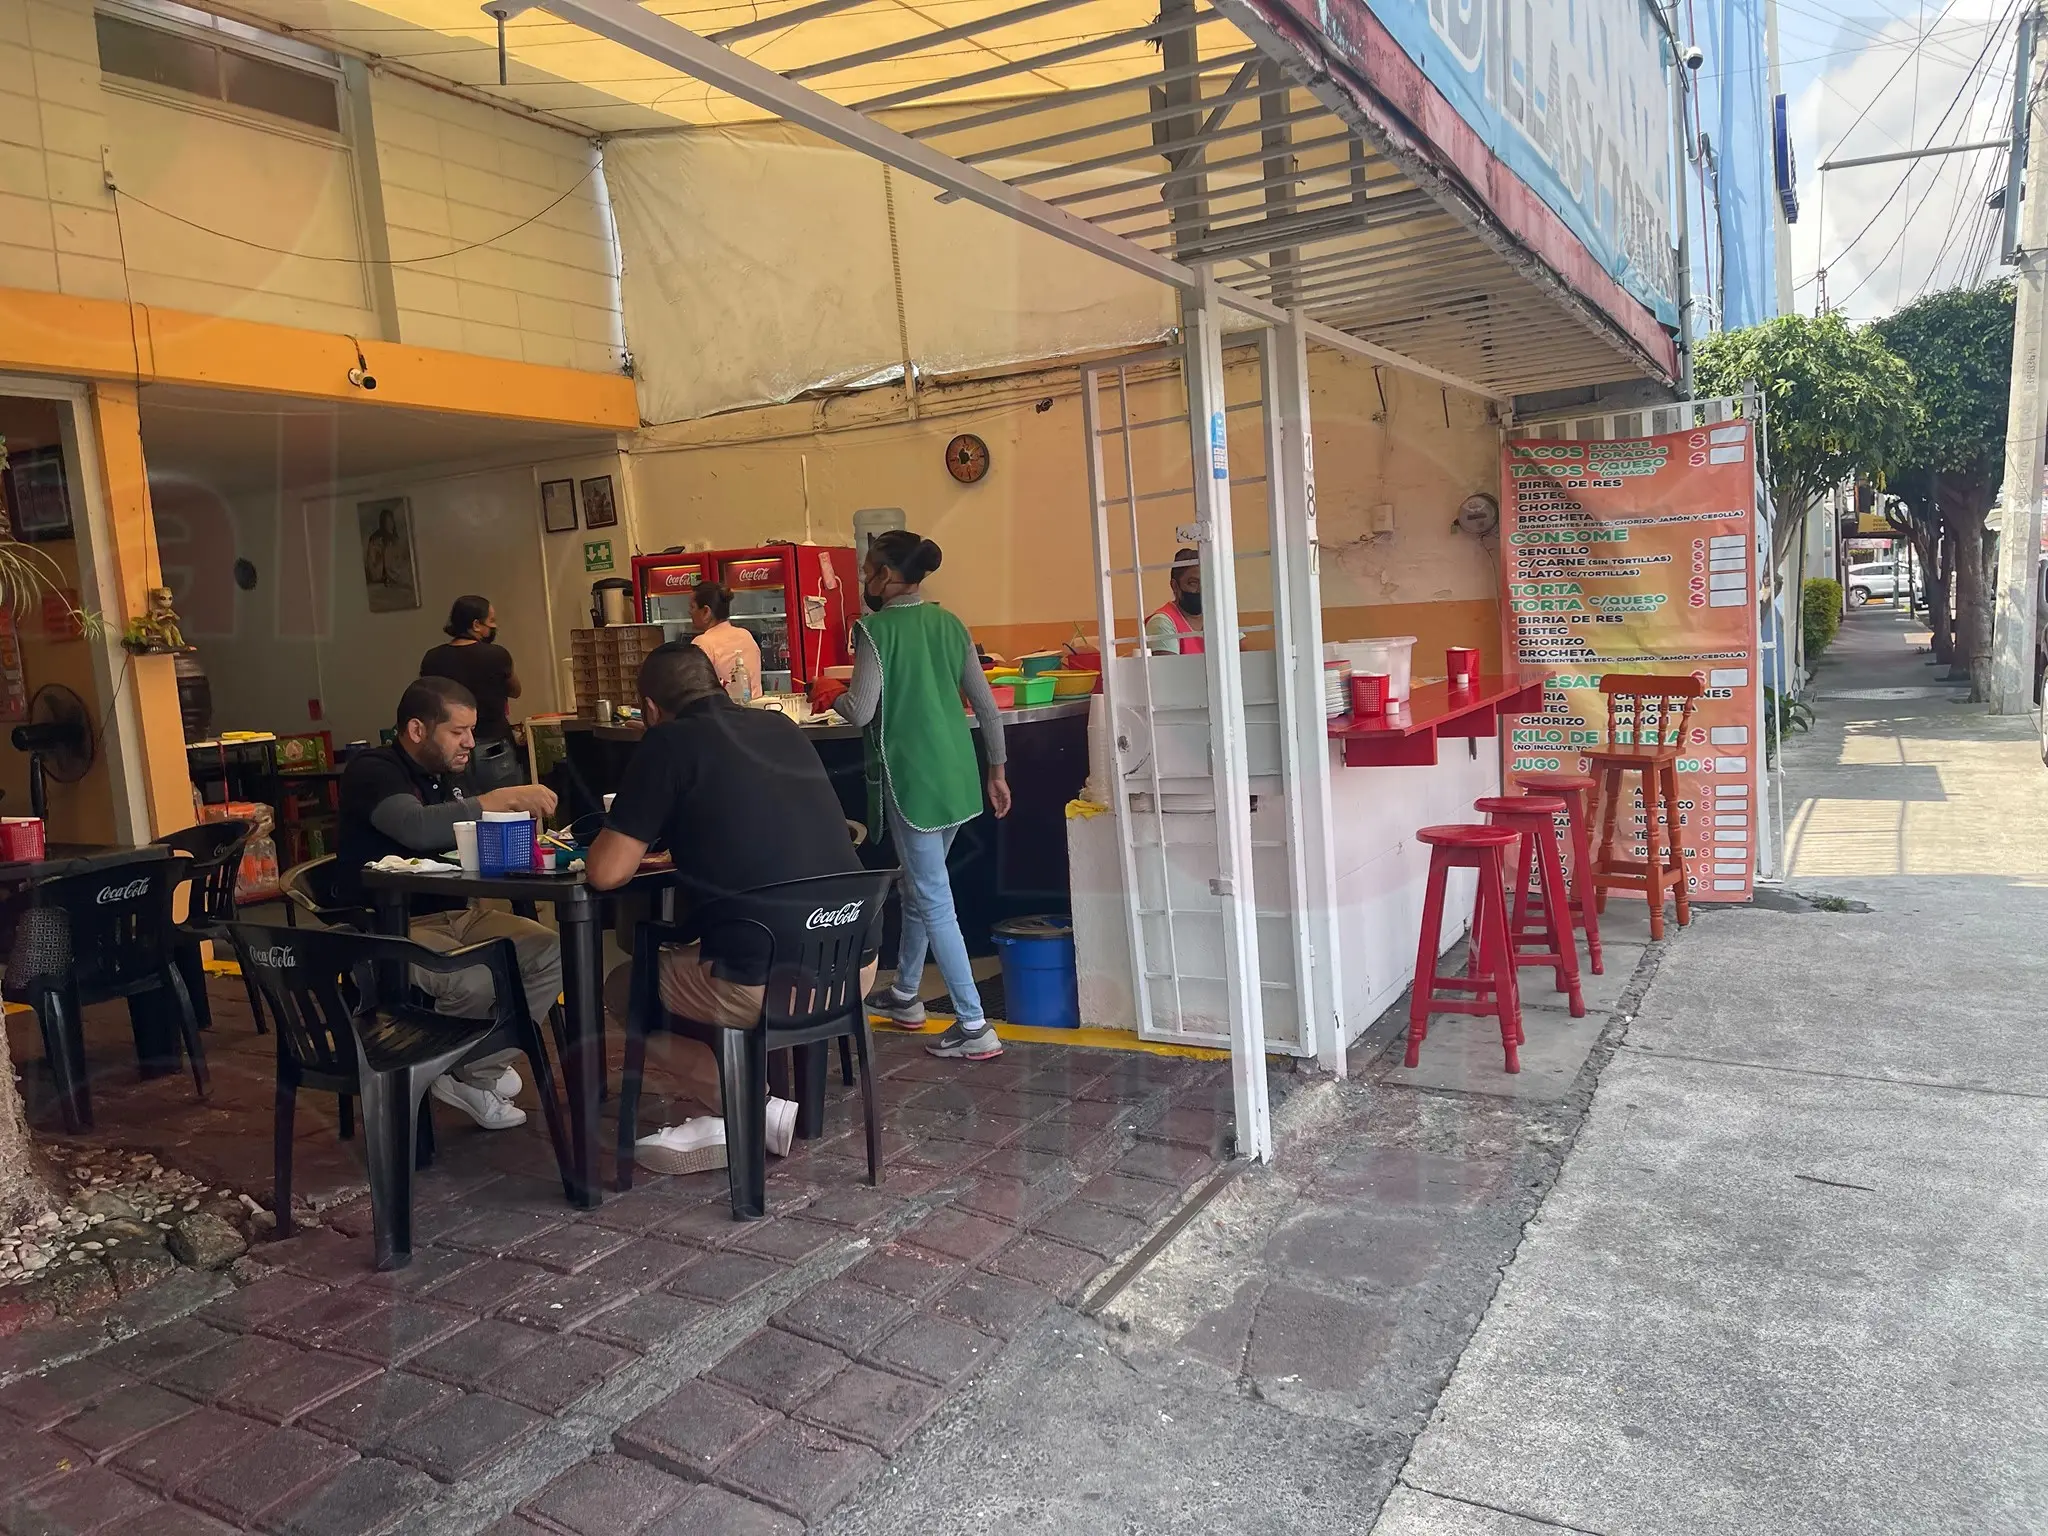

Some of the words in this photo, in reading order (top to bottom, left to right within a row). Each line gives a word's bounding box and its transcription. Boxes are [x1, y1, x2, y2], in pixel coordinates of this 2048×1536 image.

[1587, 100, 1604, 230] Y
[1606, 138, 1674, 304] TORTAS
[1590, 441, 1651, 450] SUAVES
[1511, 446, 1584, 458] TACOS
[1590, 447, 1668, 459] DORADOS
[1511, 464, 1584, 477] TACOS
[1588, 458, 1666, 473] C/QUESO
[1601, 467, 1656, 478] (OAXACA)
[1518, 481, 1563, 490] BIRRIA
[1567, 480, 1588, 488] DE
[1592, 479, 1622, 487] RES
[1518, 492, 1566, 501] BISTEC
[1518, 502, 1582, 512] CHORIZO
[1518, 513, 1594, 523] BROCHETA
[1659, 515, 1690, 523] JAMÓN
[1701, 511, 1744, 520] CEBOLLA)
[1510, 529, 1628, 544] CONSOME
[1518, 547, 1589, 557] SENCILLO
[1518, 558, 1586, 568] C/CARNE
[1611, 555, 1672, 565] TORTILLAS)
[1518, 569, 1564, 579] PLATO
[1566, 569, 1640, 577] (C/TORTILLAS)
[1510, 583, 1583, 597] TORTA
[1510, 599, 1583, 612] TORTA
[1588, 594, 1667, 606] C/QUESO
[1602, 604, 1657, 613] (OAXACA)
[1518, 616, 1567, 624] BIRRIA
[1571, 615, 1591, 623] DE
[1595, 615, 1624, 623] RES
[1518, 627, 1568, 635] BISTEC
[1518, 638, 1585, 646] CHORIZO
[1519, 649, 1596, 657] BROCHETA
[1520, 717, 1585, 726] CHORIZO
[1512, 730, 1563, 743] KILO
[1570, 731, 1599, 744] DE
[1533, 744, 1574, 752] INCLUYE
[1513, 758, 1560, 771] JUGO
[1578, 758, 1588, 772] $
[805, 900, 864, 929] Coca-Cola
